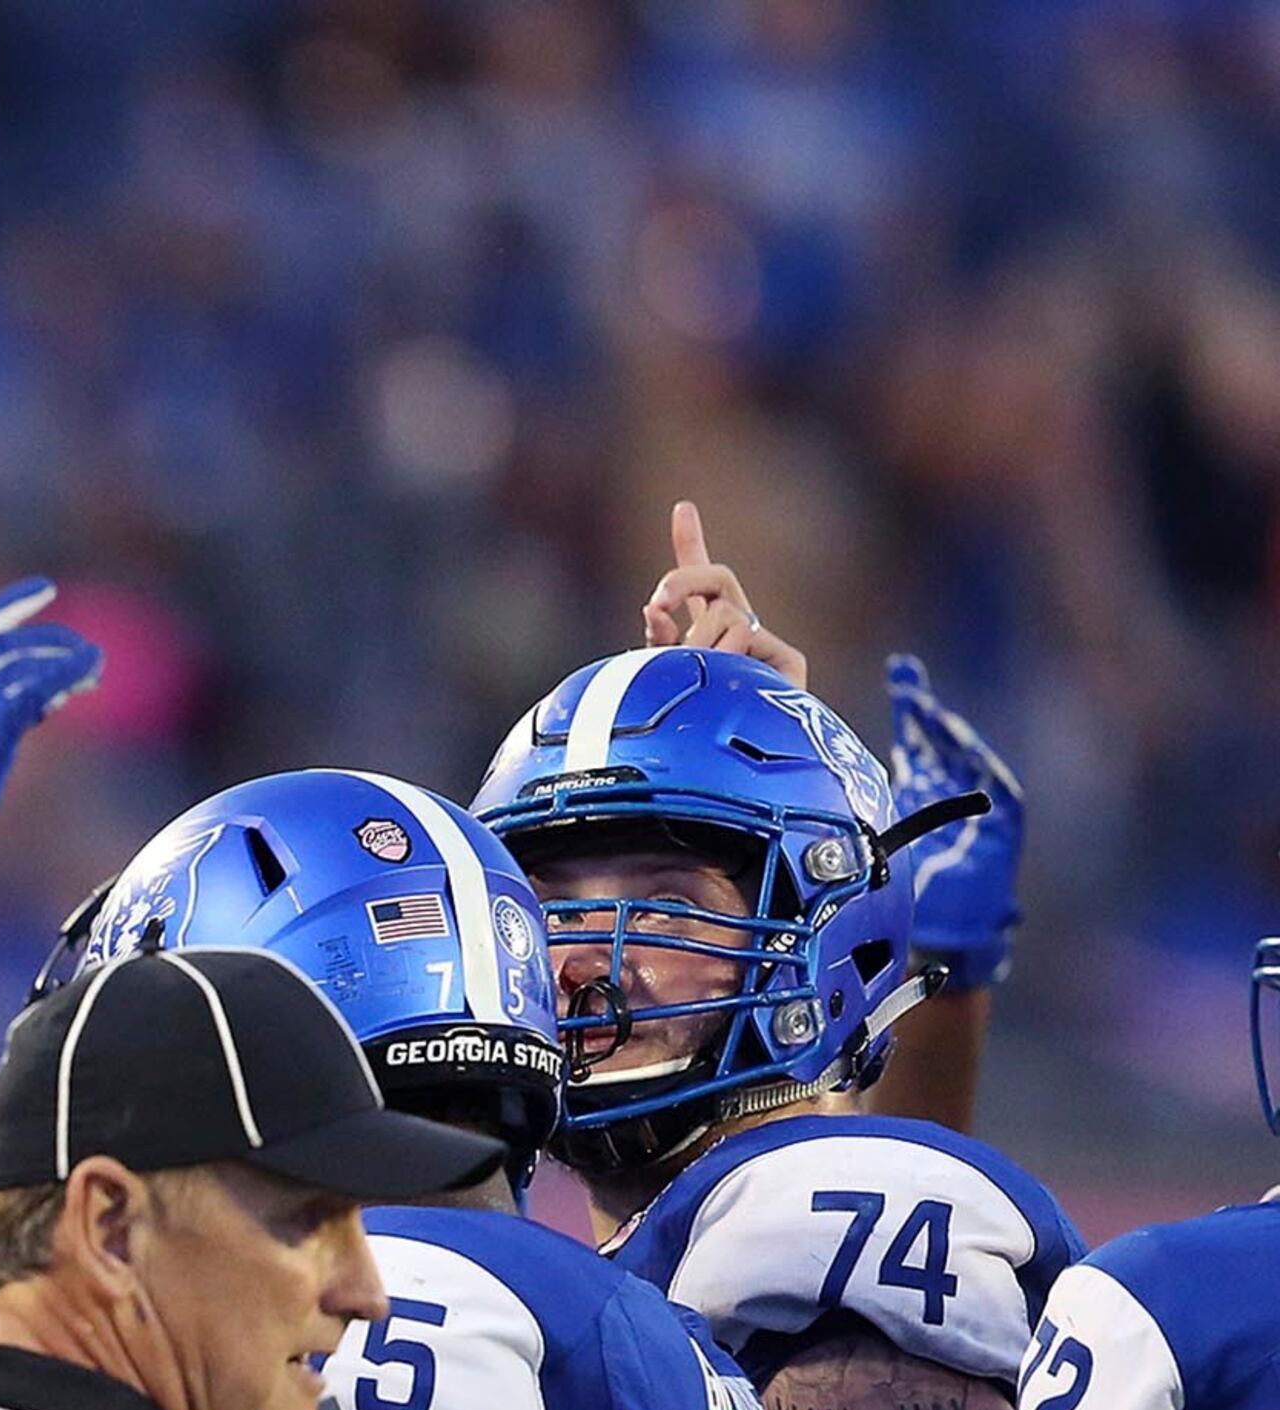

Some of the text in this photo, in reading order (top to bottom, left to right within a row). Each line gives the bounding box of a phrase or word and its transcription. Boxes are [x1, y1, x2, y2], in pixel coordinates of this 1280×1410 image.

[386, 1038, 562, 1080] GEORGIA STATE
[811, 1190, 959, 1327] 74
